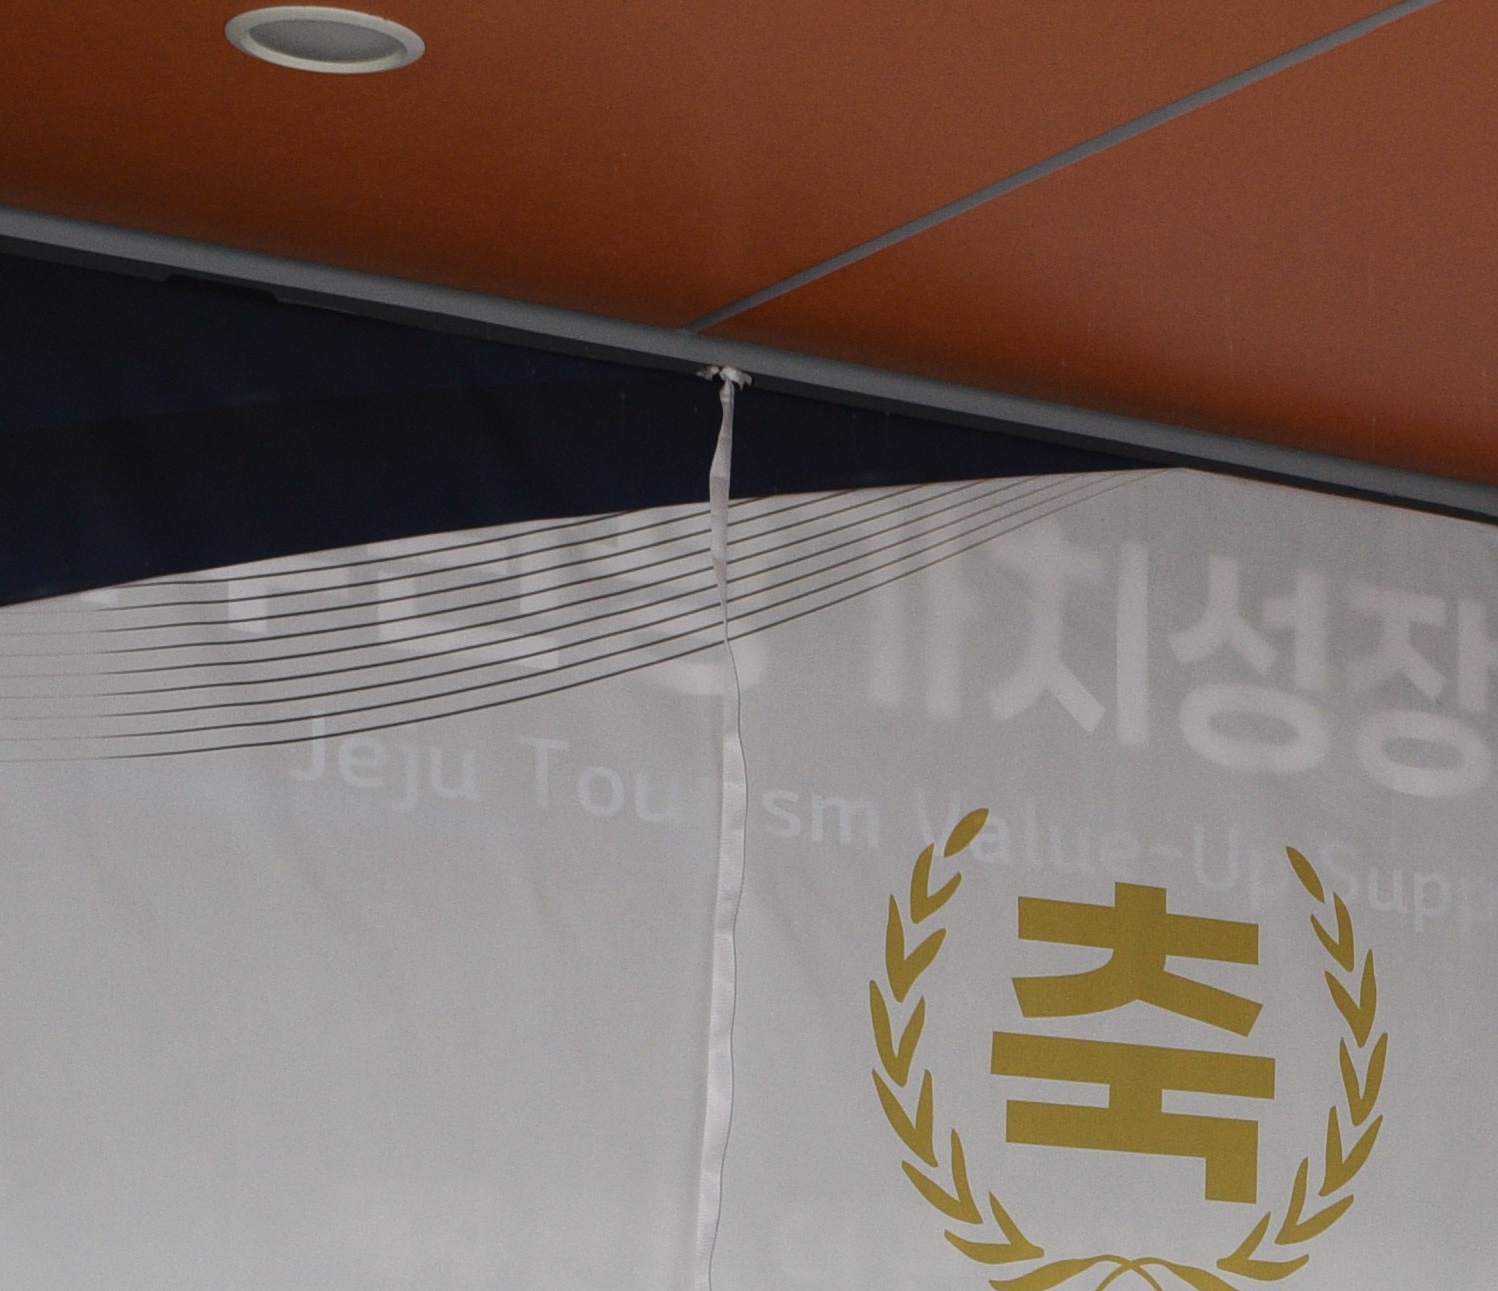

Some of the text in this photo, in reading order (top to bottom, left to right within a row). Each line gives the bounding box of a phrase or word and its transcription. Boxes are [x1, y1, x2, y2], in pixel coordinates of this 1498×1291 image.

[291, 710, 480, 815] Jeju
[516, 733, 883, 852] Tousm
[990, 881, 1276, 1205] 축
